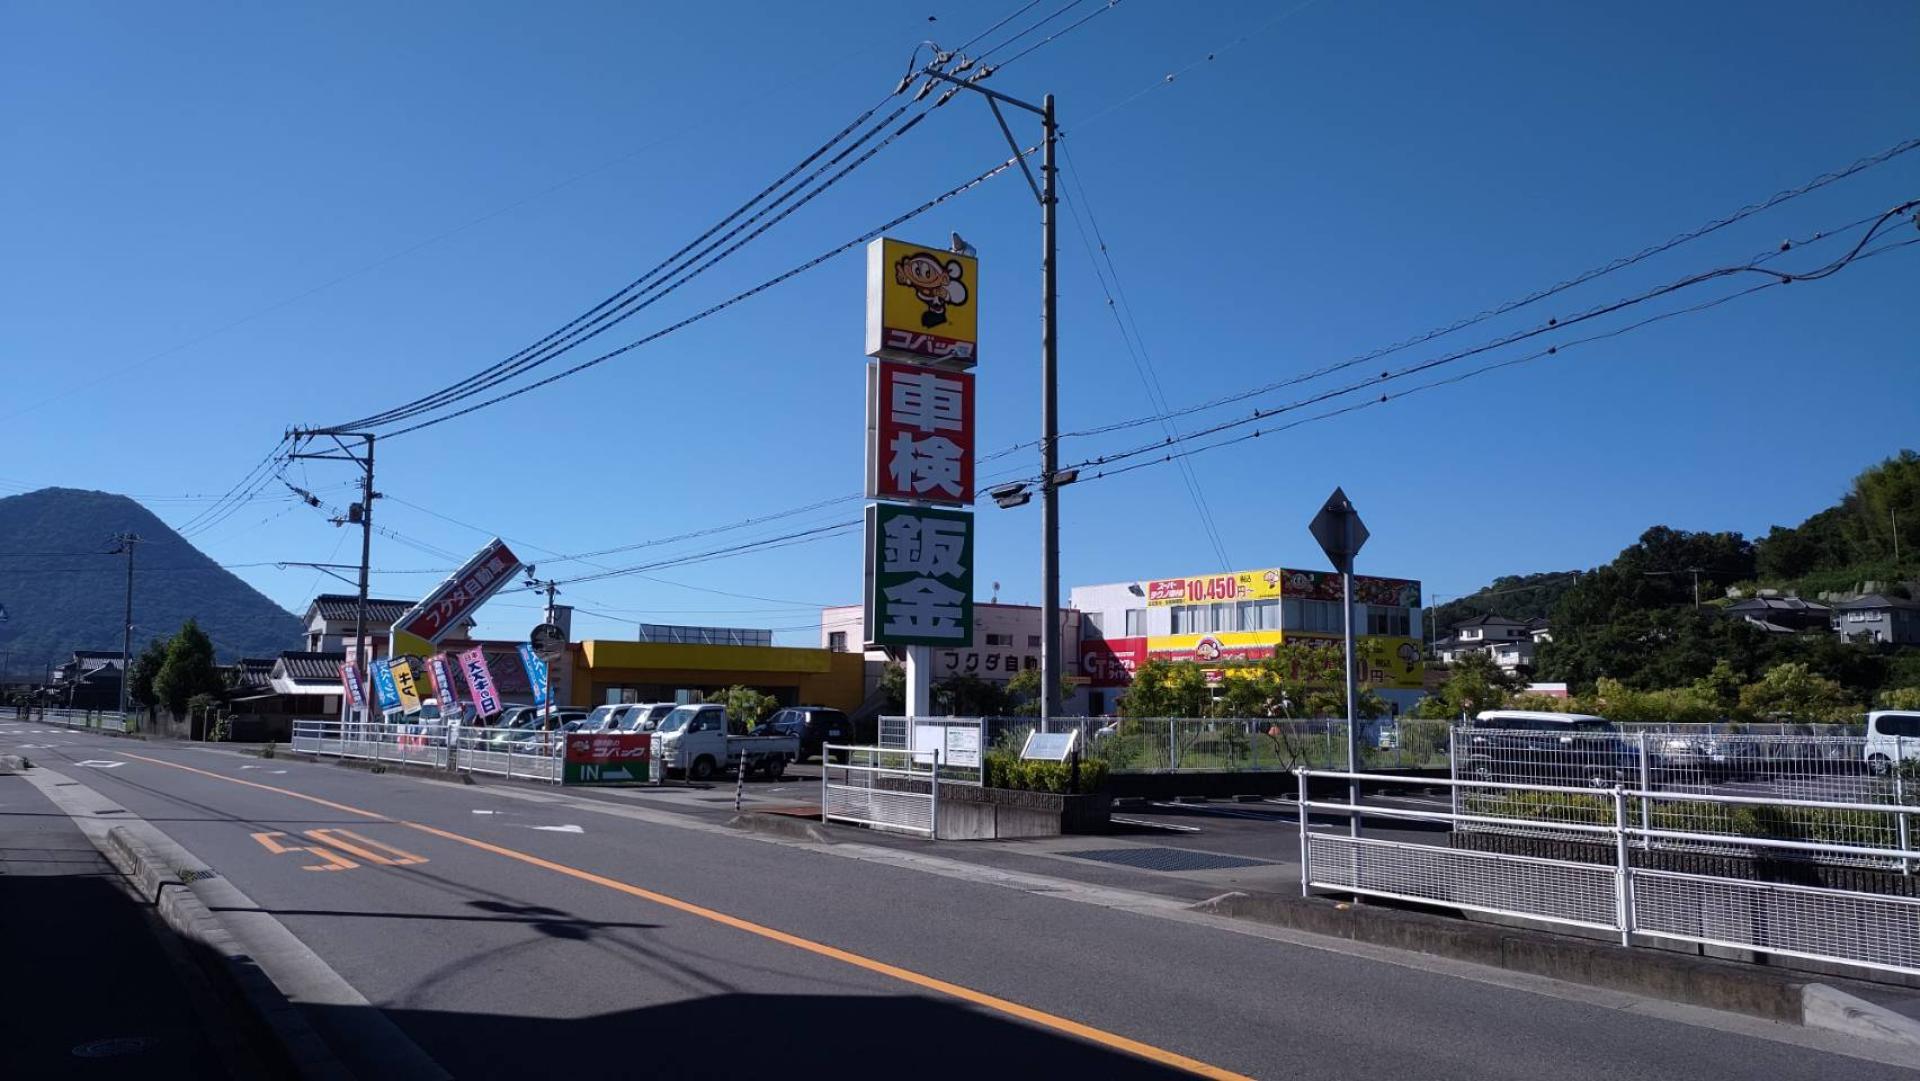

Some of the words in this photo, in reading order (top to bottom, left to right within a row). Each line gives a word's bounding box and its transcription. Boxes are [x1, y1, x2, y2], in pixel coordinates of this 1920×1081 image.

[887, 330, 974, 358] コバック
[888, 370, 965, 499] 車検
[425, 555, 505, 629] フクダ自動車
[882, 514, 968, 639] 鈑金
[580, 765, 599, 781] IN
[592, 747, 646, 758] コバック
[249, 828, 432, 872] 50
